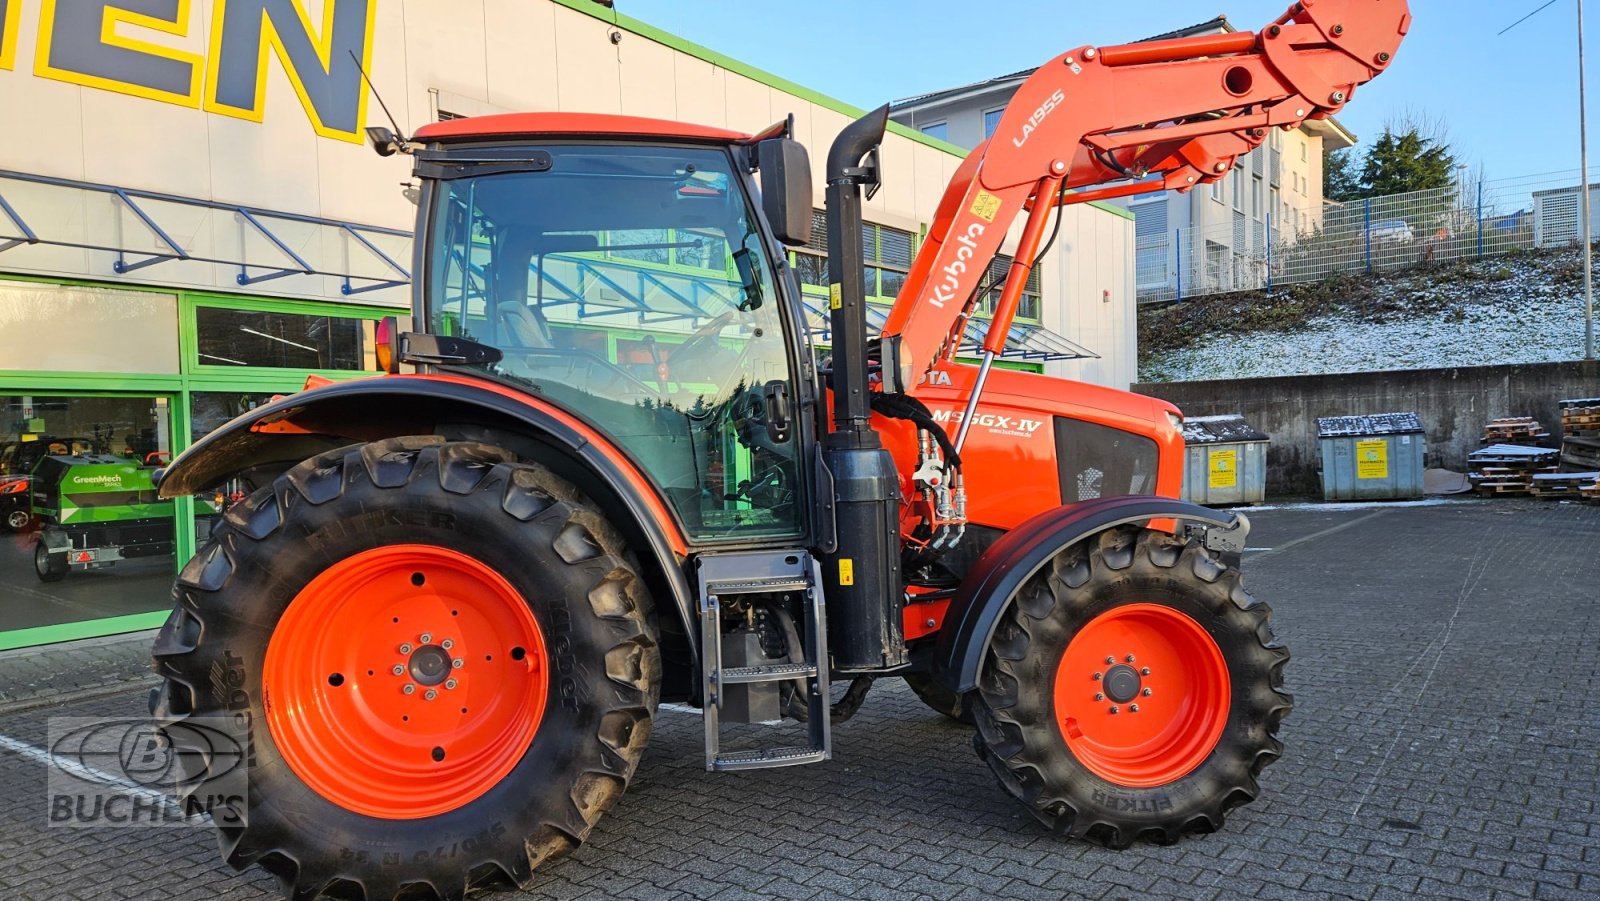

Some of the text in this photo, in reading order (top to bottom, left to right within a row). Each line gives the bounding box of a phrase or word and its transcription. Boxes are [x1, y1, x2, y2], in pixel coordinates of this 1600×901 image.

[0, 0, 375, 145] EN
[1013, 88, 1065, 148] LA1955
[928, 222, 986, 309] Kubota
[73, 474, 122, 484] GreenMech
